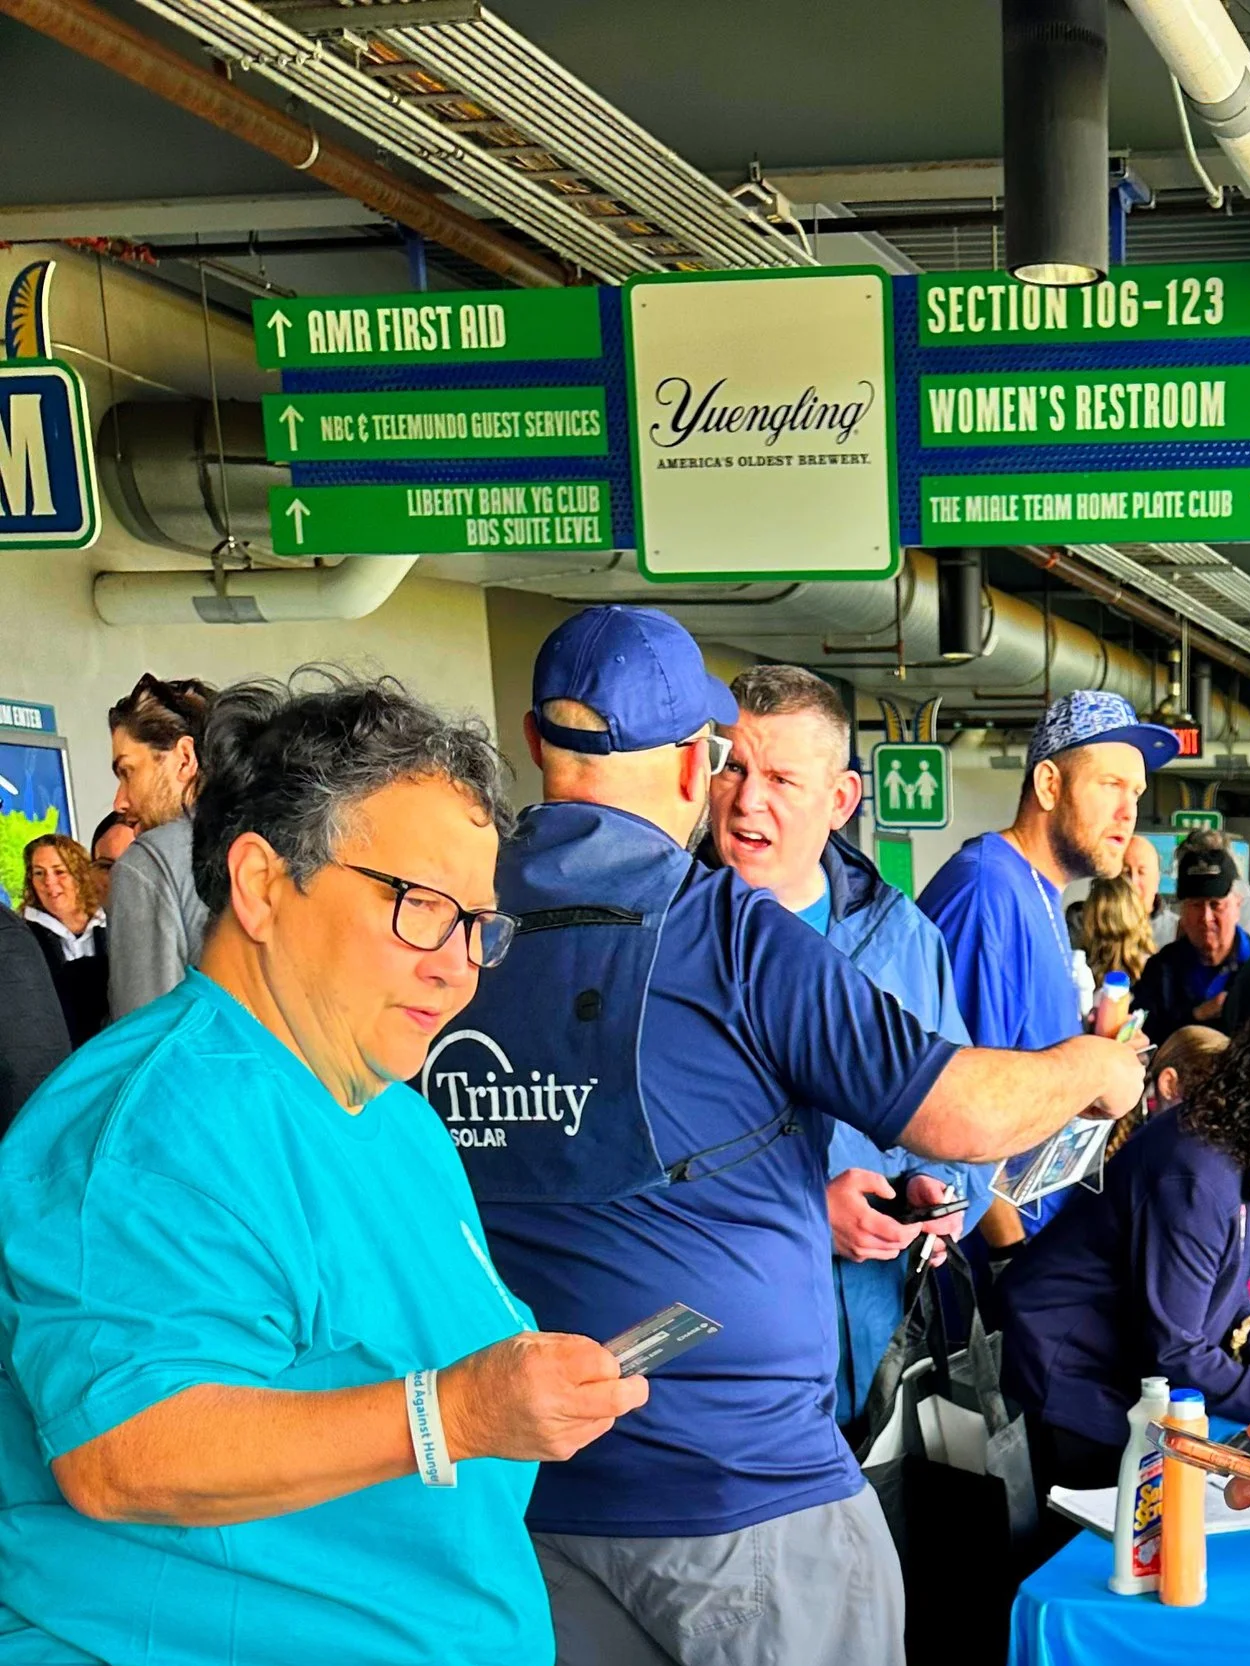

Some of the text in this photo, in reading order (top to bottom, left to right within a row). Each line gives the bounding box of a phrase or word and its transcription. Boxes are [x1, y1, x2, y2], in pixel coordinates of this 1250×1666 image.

[927, 277, 1224, 334] SECTION 106-123
[307, 304, 506, 354] AMR FIRST AID
[321, 409, 600, 443] NBC & TELEMUNDO GUEST SERVICES
[649, 377, 875, 448] Yuengling
[929, 381, 1226, 433] WOMEN'S RESTROOM
[657, 456, 733, 469] AMERICA'S
[738, 455, 794, 468] OLDEST
[407, 485, 600, 517] LIBERTY BANK YG CLUB
[930, 490, 1233, 523] THE MIALE TEAM HOME PLATE CLUB
[466, 516, 602, 546] BDS SUITE LEVEL
[435, 1070, 593, 1137] Trinity
[449, 1127, 508, 1148] SOLAR
[413, 1390, 432, 1438] Against
